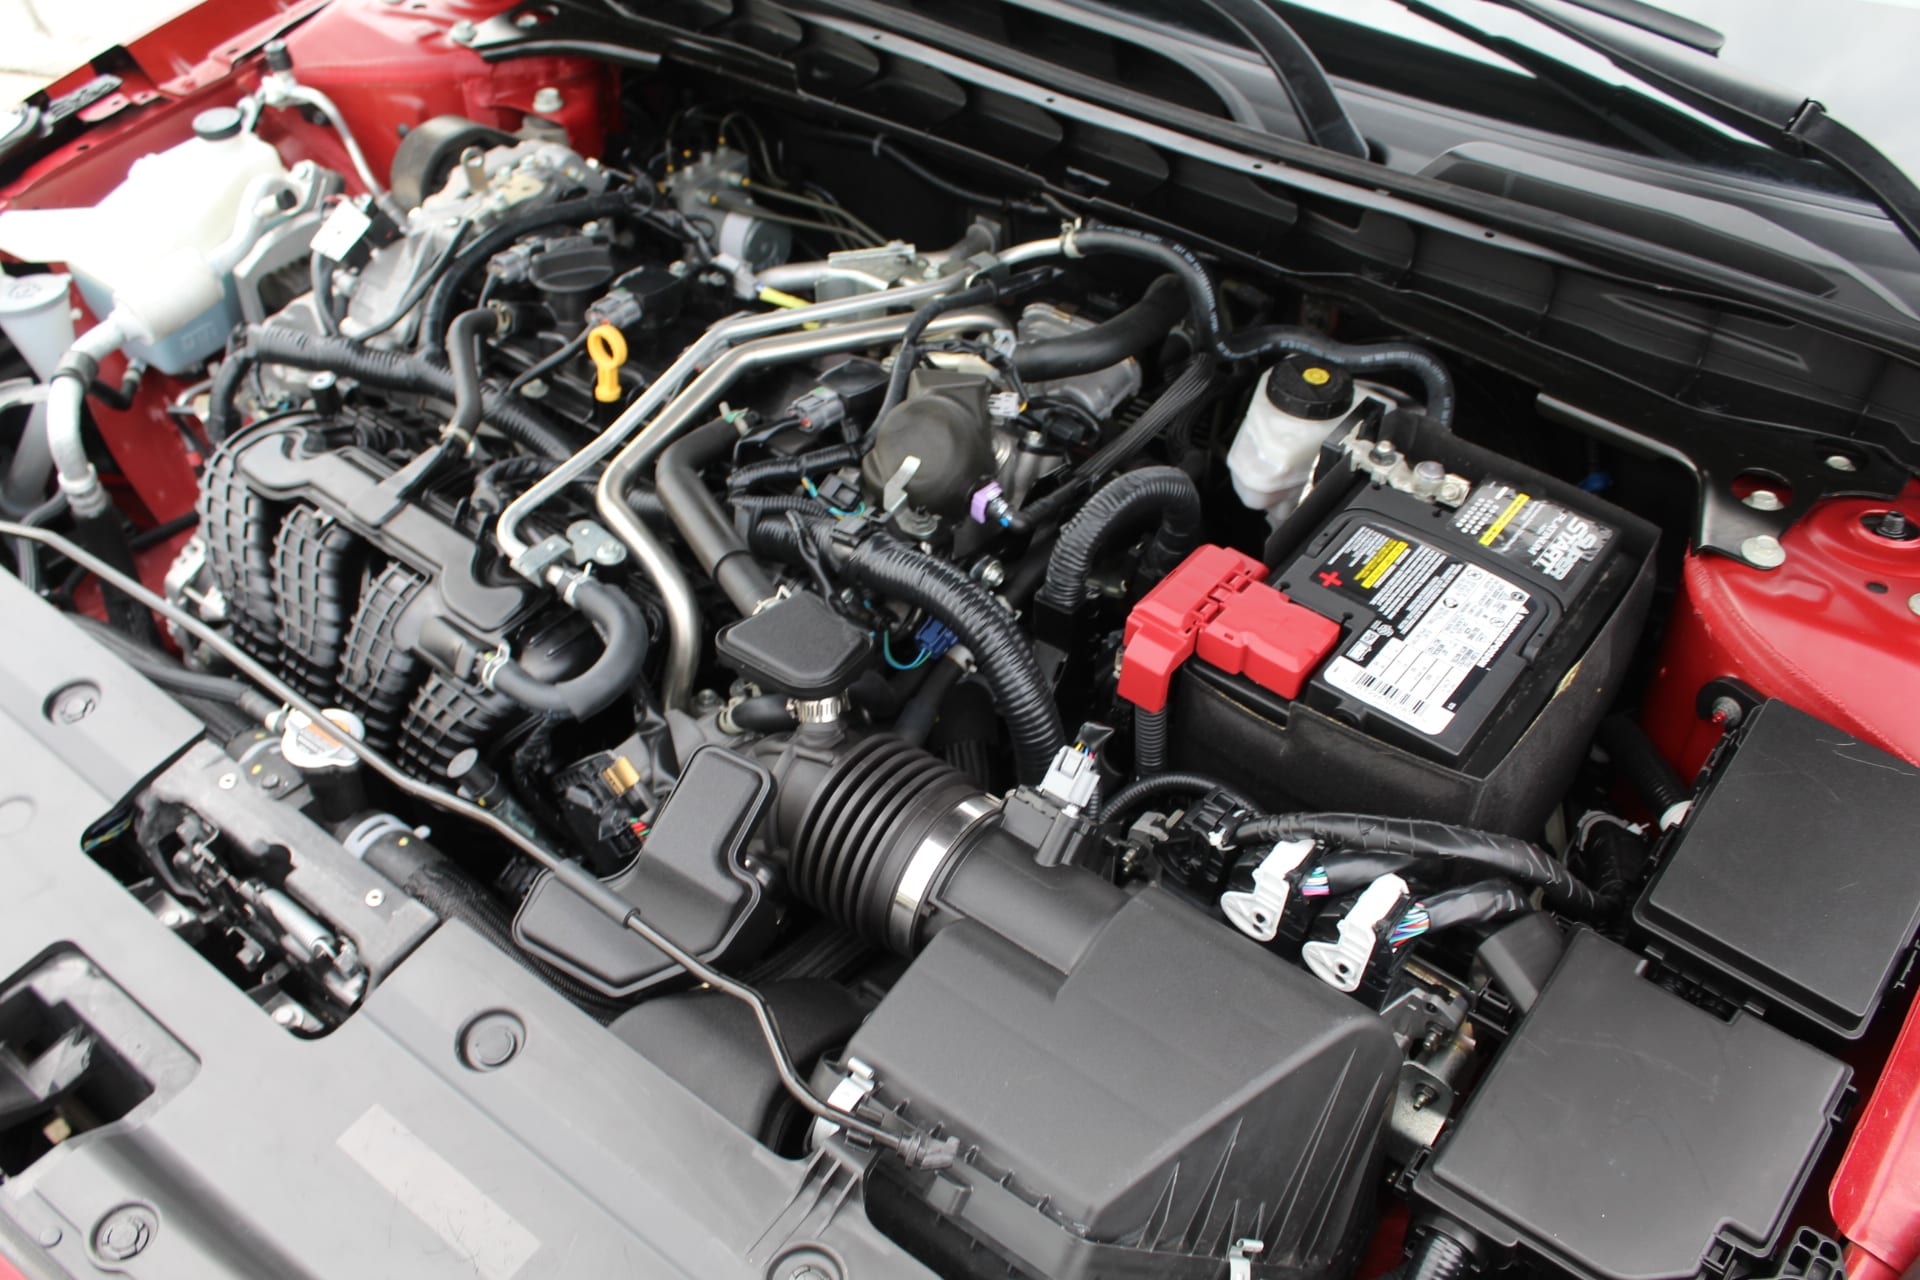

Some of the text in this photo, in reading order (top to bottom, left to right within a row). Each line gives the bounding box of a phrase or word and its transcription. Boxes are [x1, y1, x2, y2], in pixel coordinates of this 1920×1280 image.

[1528, 512, 1567, 556] PLATINUM
[1538, 517, 1589, 575] START
[1553, 531, 1598, 581] SUPER
